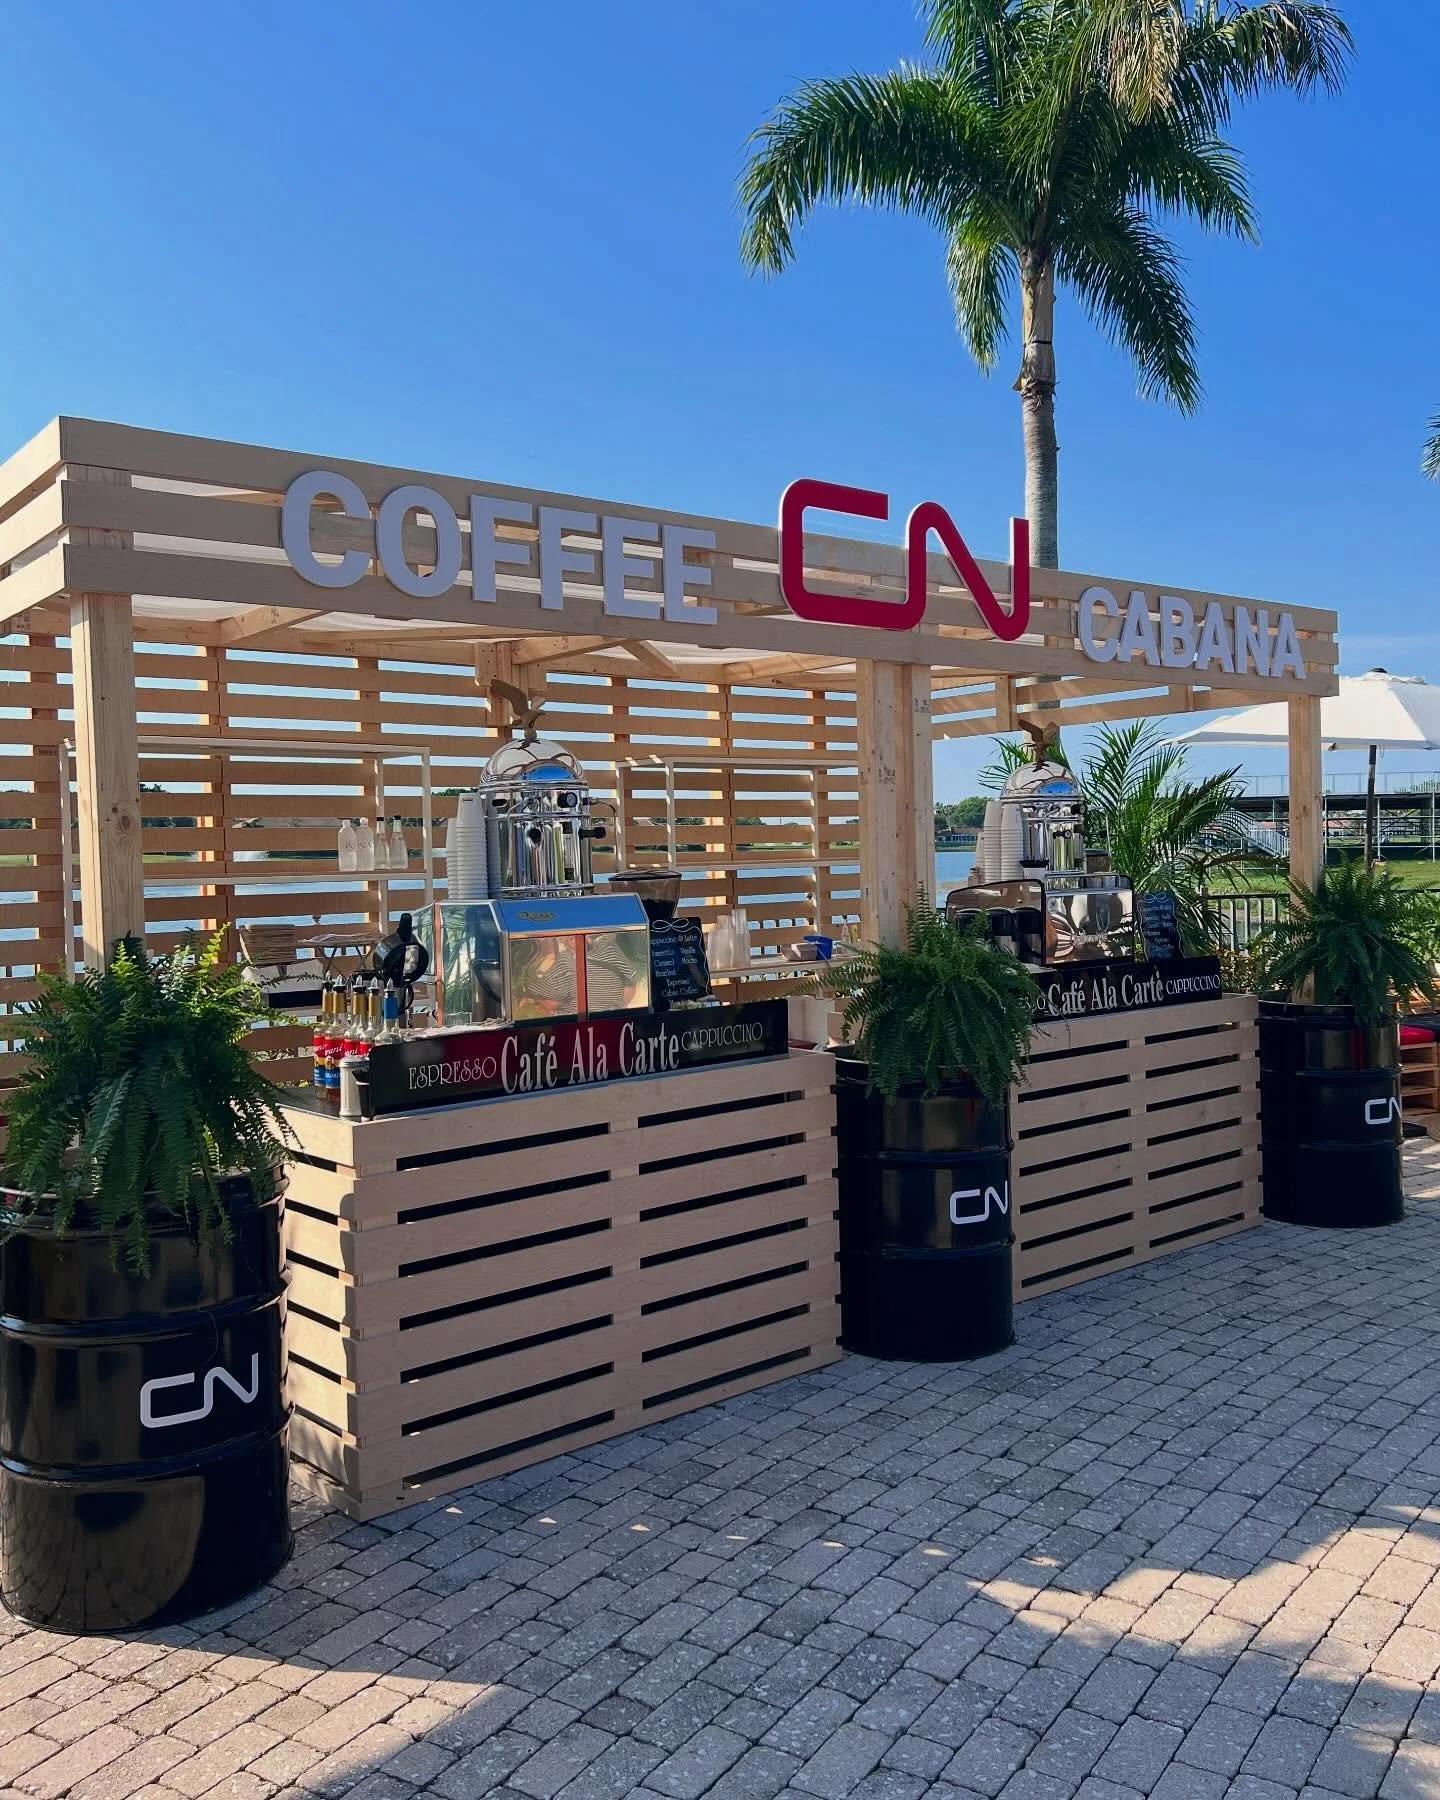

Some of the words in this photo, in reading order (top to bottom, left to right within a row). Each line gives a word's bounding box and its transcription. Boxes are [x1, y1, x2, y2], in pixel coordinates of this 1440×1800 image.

[282, 470, 718, 626] COFFEE
[778, 478, 1031, 642] CN
[1077, 586, 1307, 680] CABANA
[1047, 979, 1087, 1017] Café
[1091, 977, 1118, 1011] Ala
[1121, 972, 1165, 1006] Carte
[1166, 973, 1221, 996] CAPPUCCINO
[407, 1056, 497, 1092] ESPRESSO
[501, 1032, 558, 1095] Café
[568, 1026, 609, 1086] Ala
[619, 1020, 680, 1078] Carte
[681, 1021, 764, 1051] CAPPUCCINO
[949, 1180, 1009, 1225] CN
[139, 1352, 259, 1428] CN
